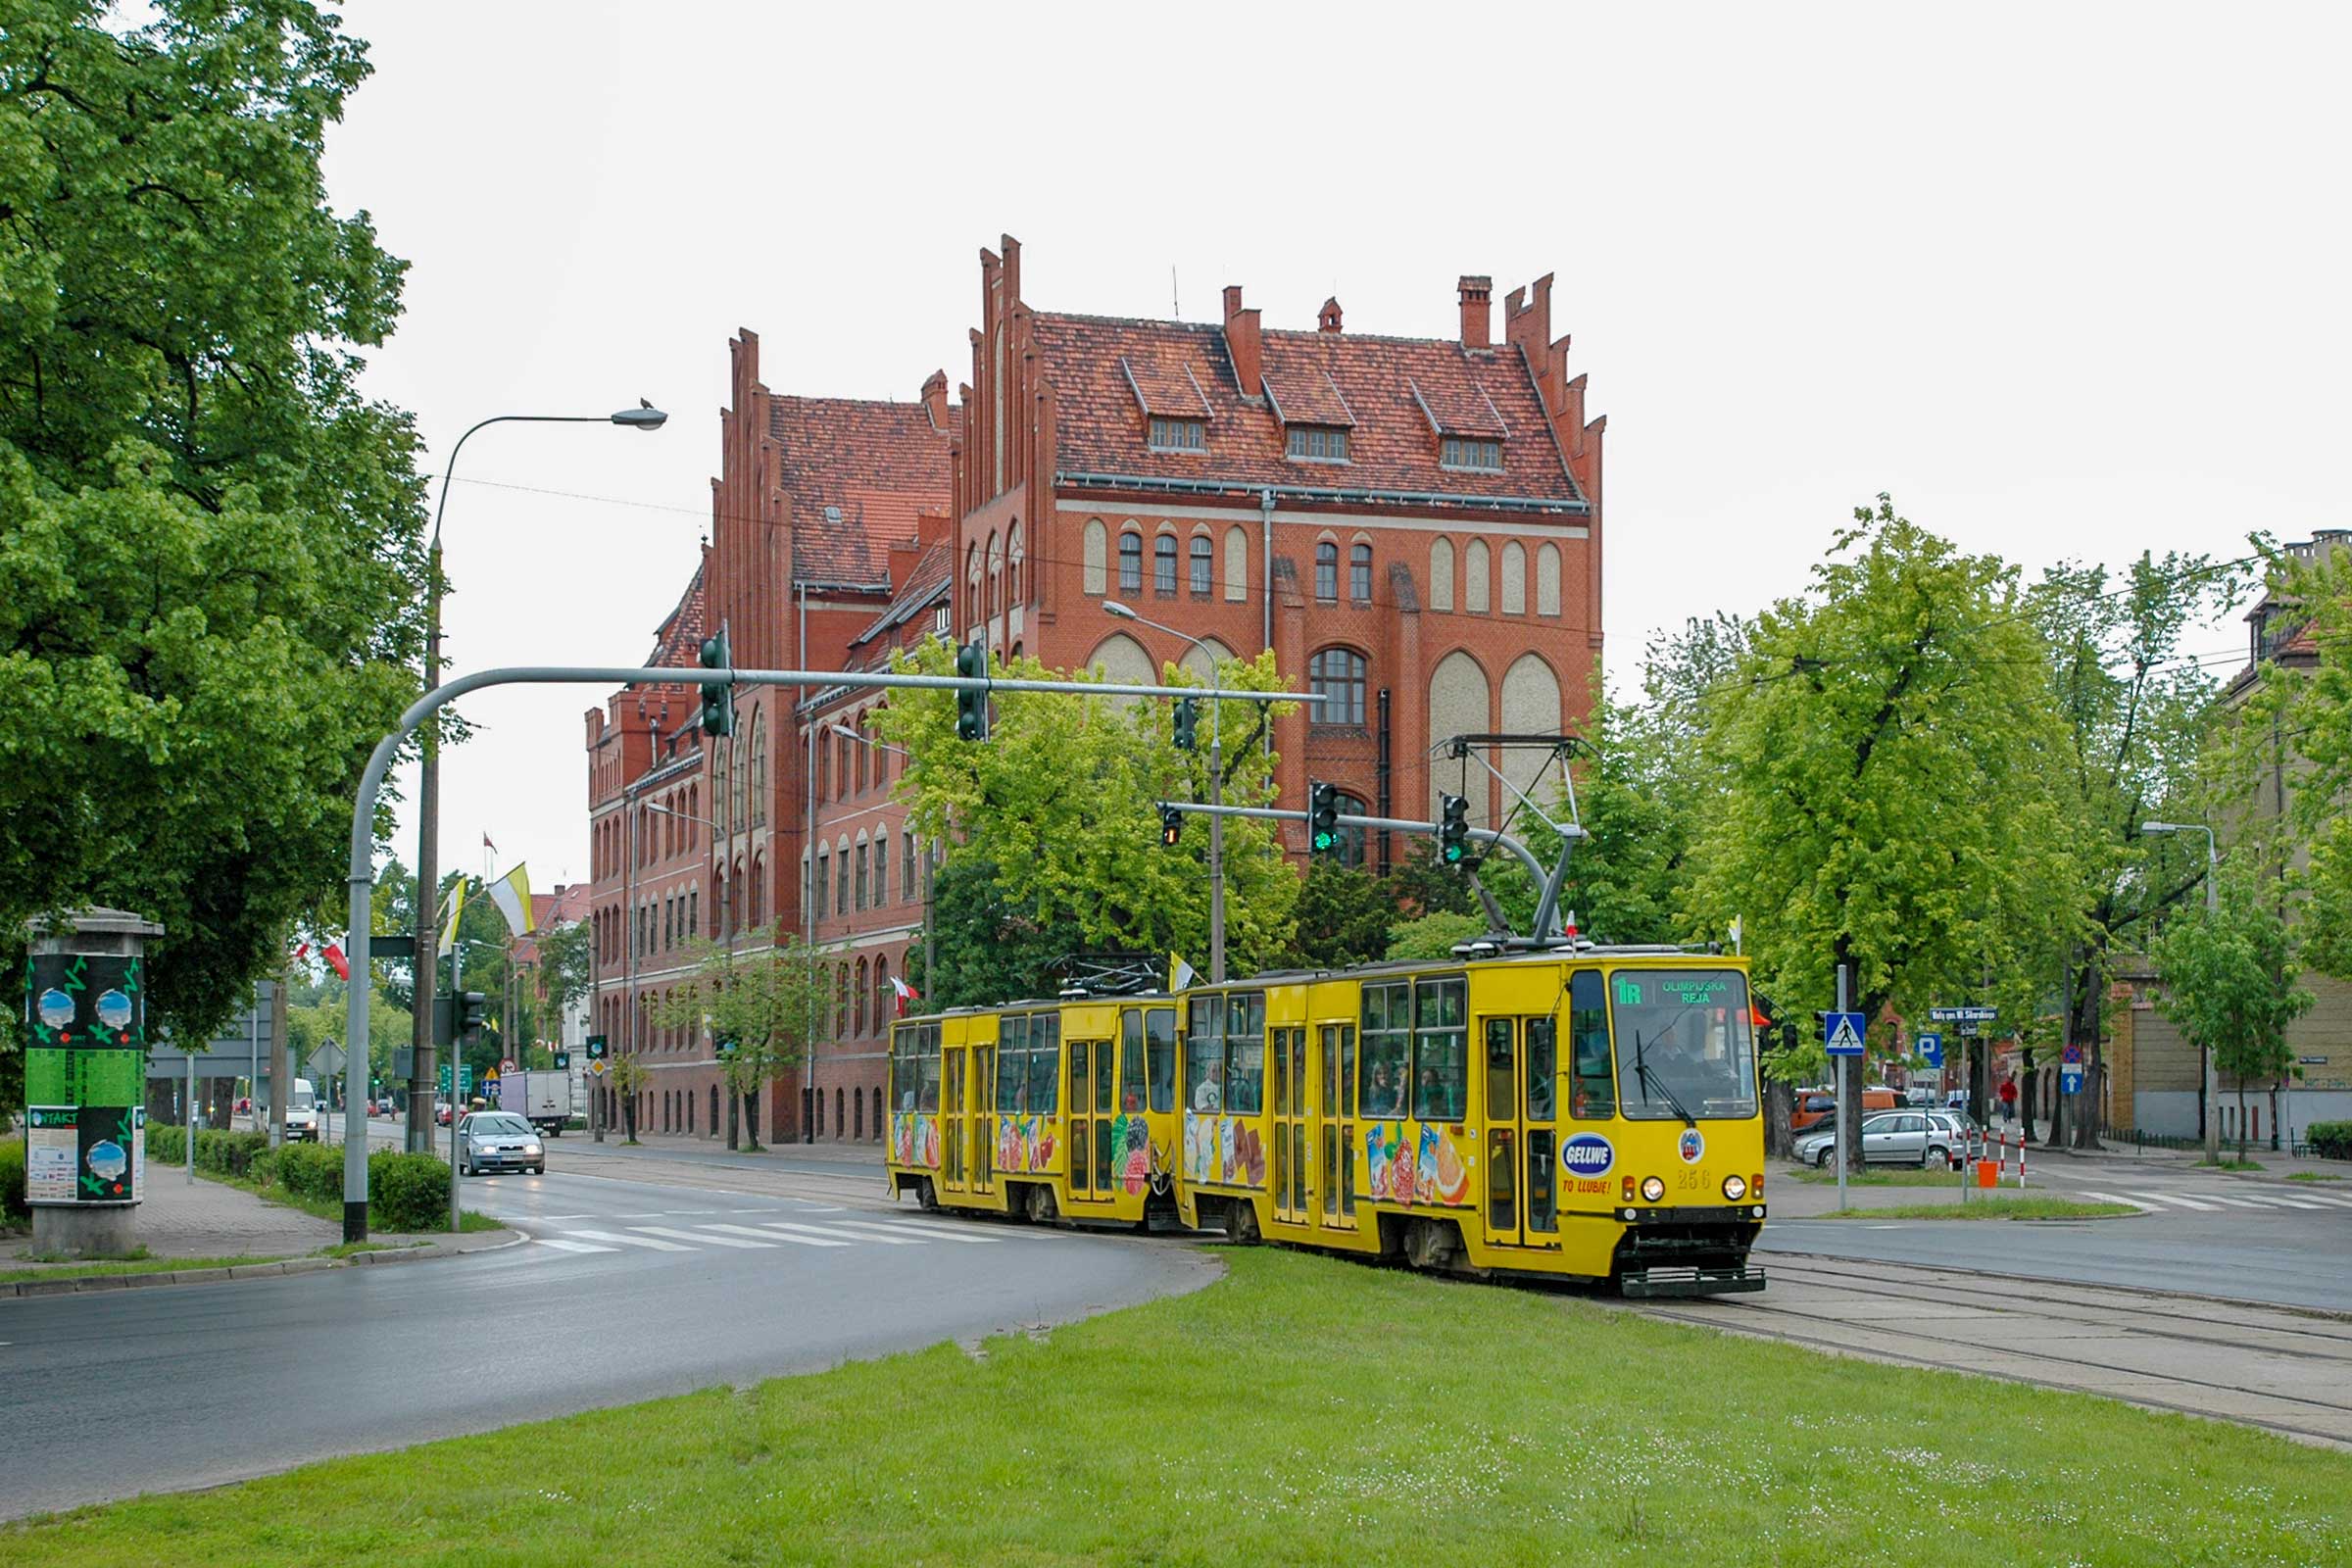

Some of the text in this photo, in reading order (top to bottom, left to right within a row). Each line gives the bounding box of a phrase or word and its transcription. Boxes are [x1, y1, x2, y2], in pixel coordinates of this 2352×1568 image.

[1613, 976, 1641, 1004] 1R
[1682, 993, 1710, 1004] REJA
[1566, 1146, 1608, 1165] GELLWE
[1563, 1180, 1574, 1193] TO
